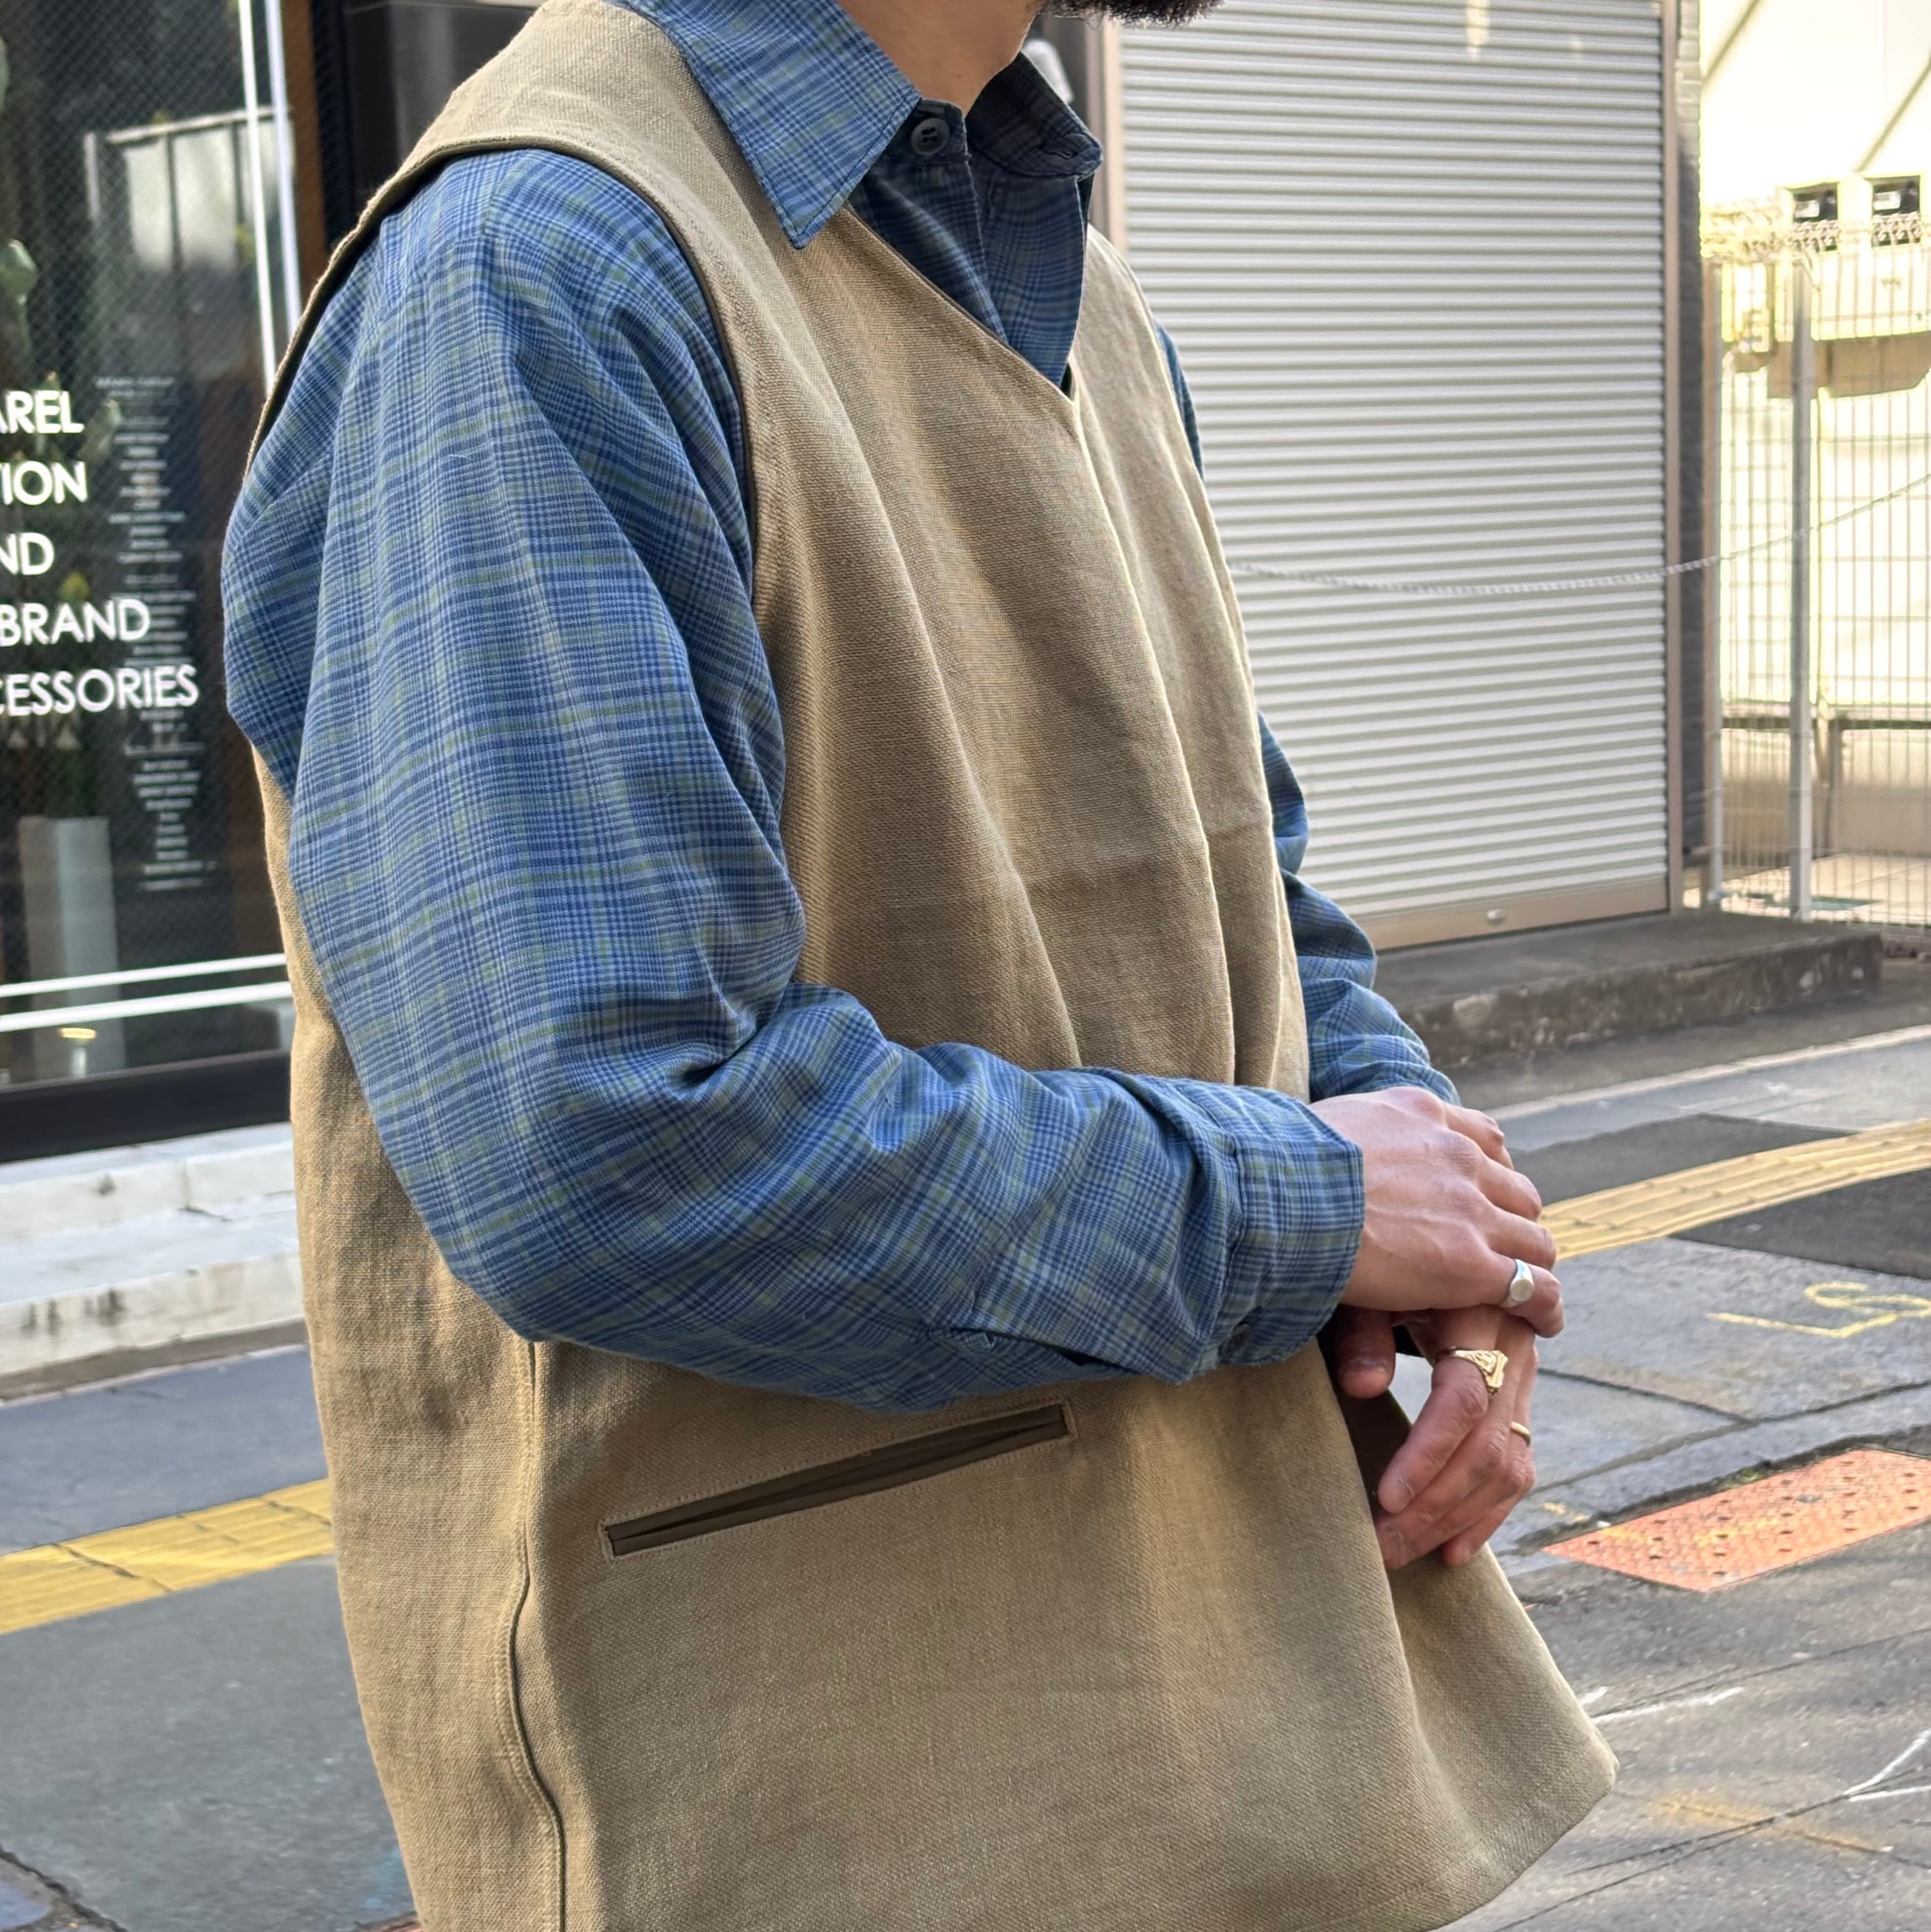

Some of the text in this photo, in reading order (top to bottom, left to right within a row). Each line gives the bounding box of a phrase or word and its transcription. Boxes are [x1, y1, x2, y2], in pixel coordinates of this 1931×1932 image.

[0, 390, 85, 434] REL
[0, 460, 88, 505] ION
[0, 598, 151, 646] BRAND
[0, 664, 199, 717] ESSORIES
